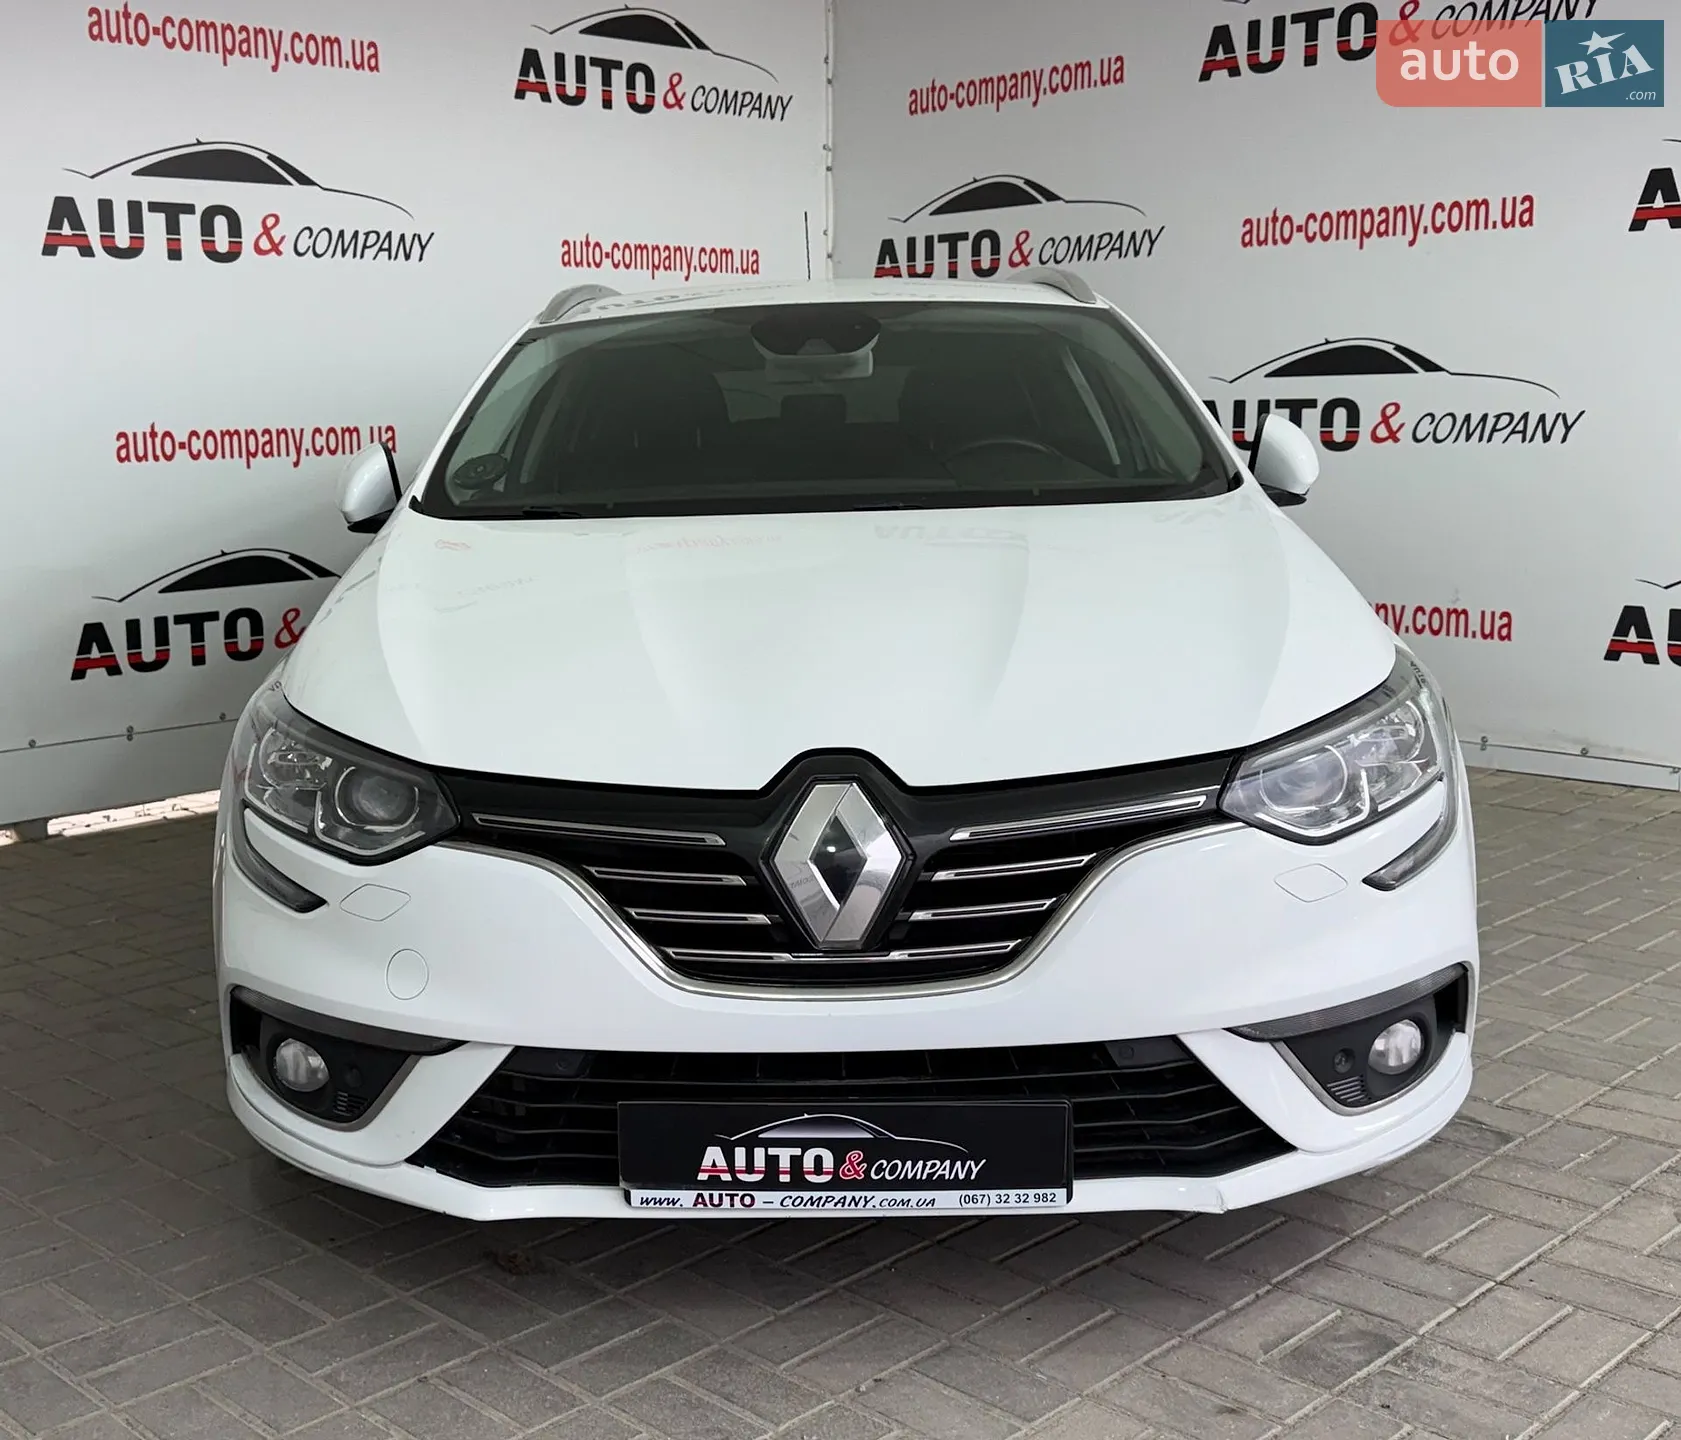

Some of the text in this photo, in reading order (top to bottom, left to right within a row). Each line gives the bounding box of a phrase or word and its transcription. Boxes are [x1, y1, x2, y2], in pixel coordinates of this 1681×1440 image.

[87, 1, 380, 73] auto-company.com.ua
[1198, 1, 1378, 83] AUTO
[1389, 0, 1425, 46] &
[513, 48, 794, 122] AUTO & COMPANY
[908, 55, 1125, 117] auto-company.com.ua
[41, 196, 435, 264] AUTO & COMPANY
[1240, 194, 1535, 250] auto-company.com.ua
[561, 233, 760, 282] auto-company.com.ua
[874, 225, 1166, 279] AUTO & COMPANY
[115, 422, 397, 470] auto-company.comua
[1370, 402, 1406, 444] &
[1411, 410, 1586, 444] COMPANY
[70, 607, 306, 681] AUTO &
[1367, 601, 1513, 642] ny.com.ua
[696, 1147, 987, 1182] AUTO & COMPANY
[639, 1195, 684, 1208] www.
[692, 1192, 756, 1209] AUTO
[958, 1193, 992, 1207] (067)
[995, 1193, 1011, 1205] 32
[1014, 1193, 1031, 1205] 32
[1033, 1192, 1057, 1204] 982
